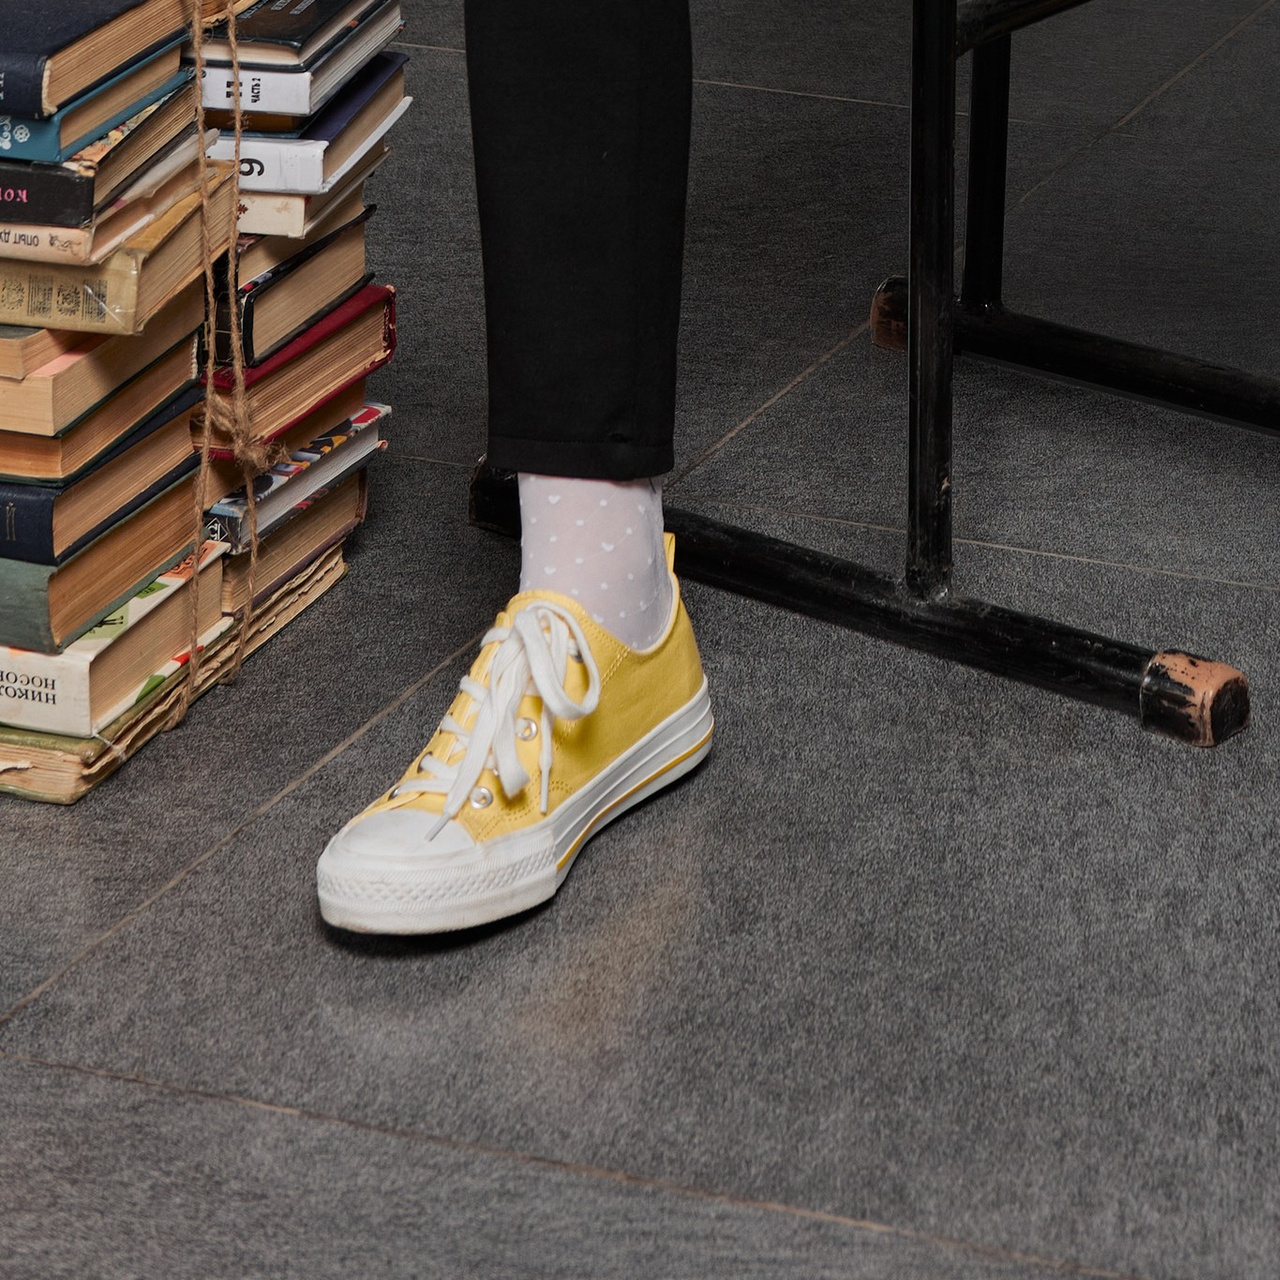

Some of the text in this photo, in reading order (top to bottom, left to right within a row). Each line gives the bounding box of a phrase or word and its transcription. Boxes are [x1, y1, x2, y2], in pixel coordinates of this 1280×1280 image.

[251, 83, 261, 104] ЧАСТЬ
[0, 186, 29, 205] КО
[12, 232, 39, 248] ОПЫТ
